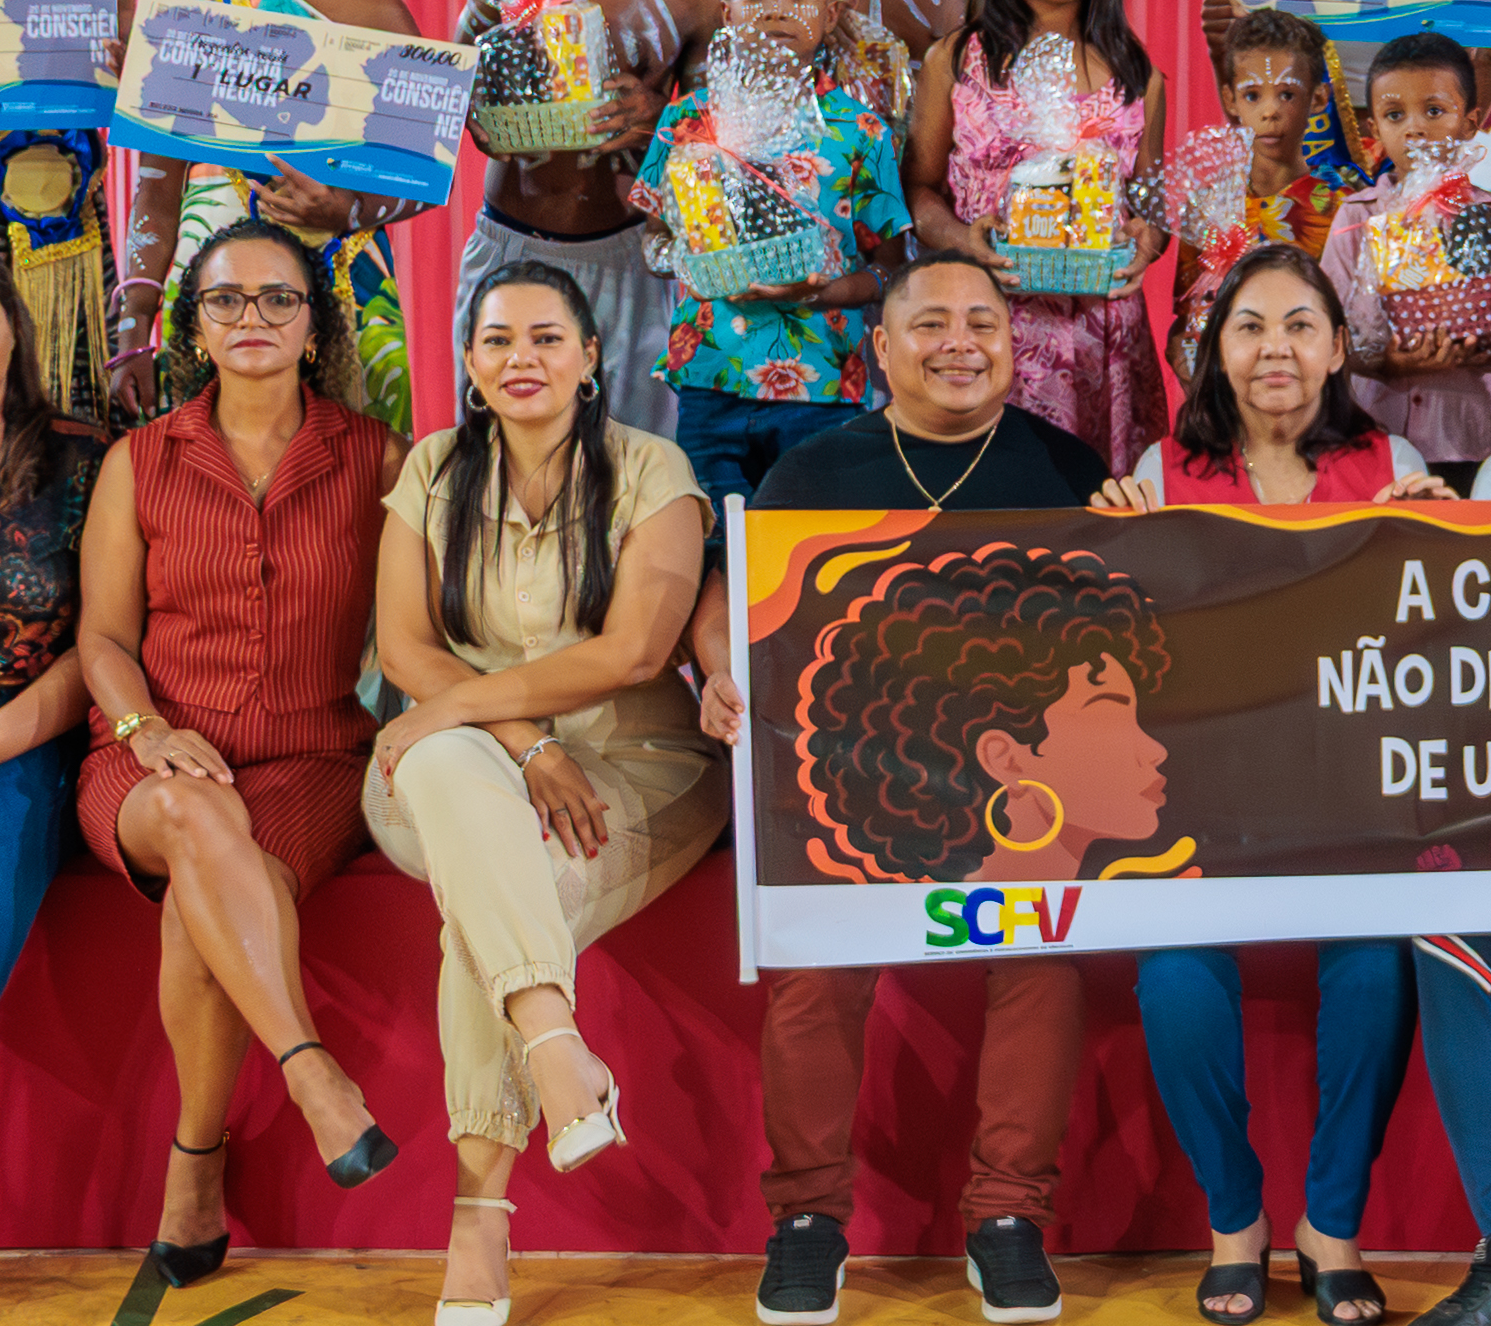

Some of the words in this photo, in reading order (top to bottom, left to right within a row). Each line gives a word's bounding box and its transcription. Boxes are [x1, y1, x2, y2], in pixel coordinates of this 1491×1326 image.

[219, 69, 313, 99] LUGAR
[1395, 560, 1436, 624] A
[1316, 635, 1435, 714] NÃO
[1379, 736, 1449, 802] DE
[925, 885, 1084, 948] SCFV
